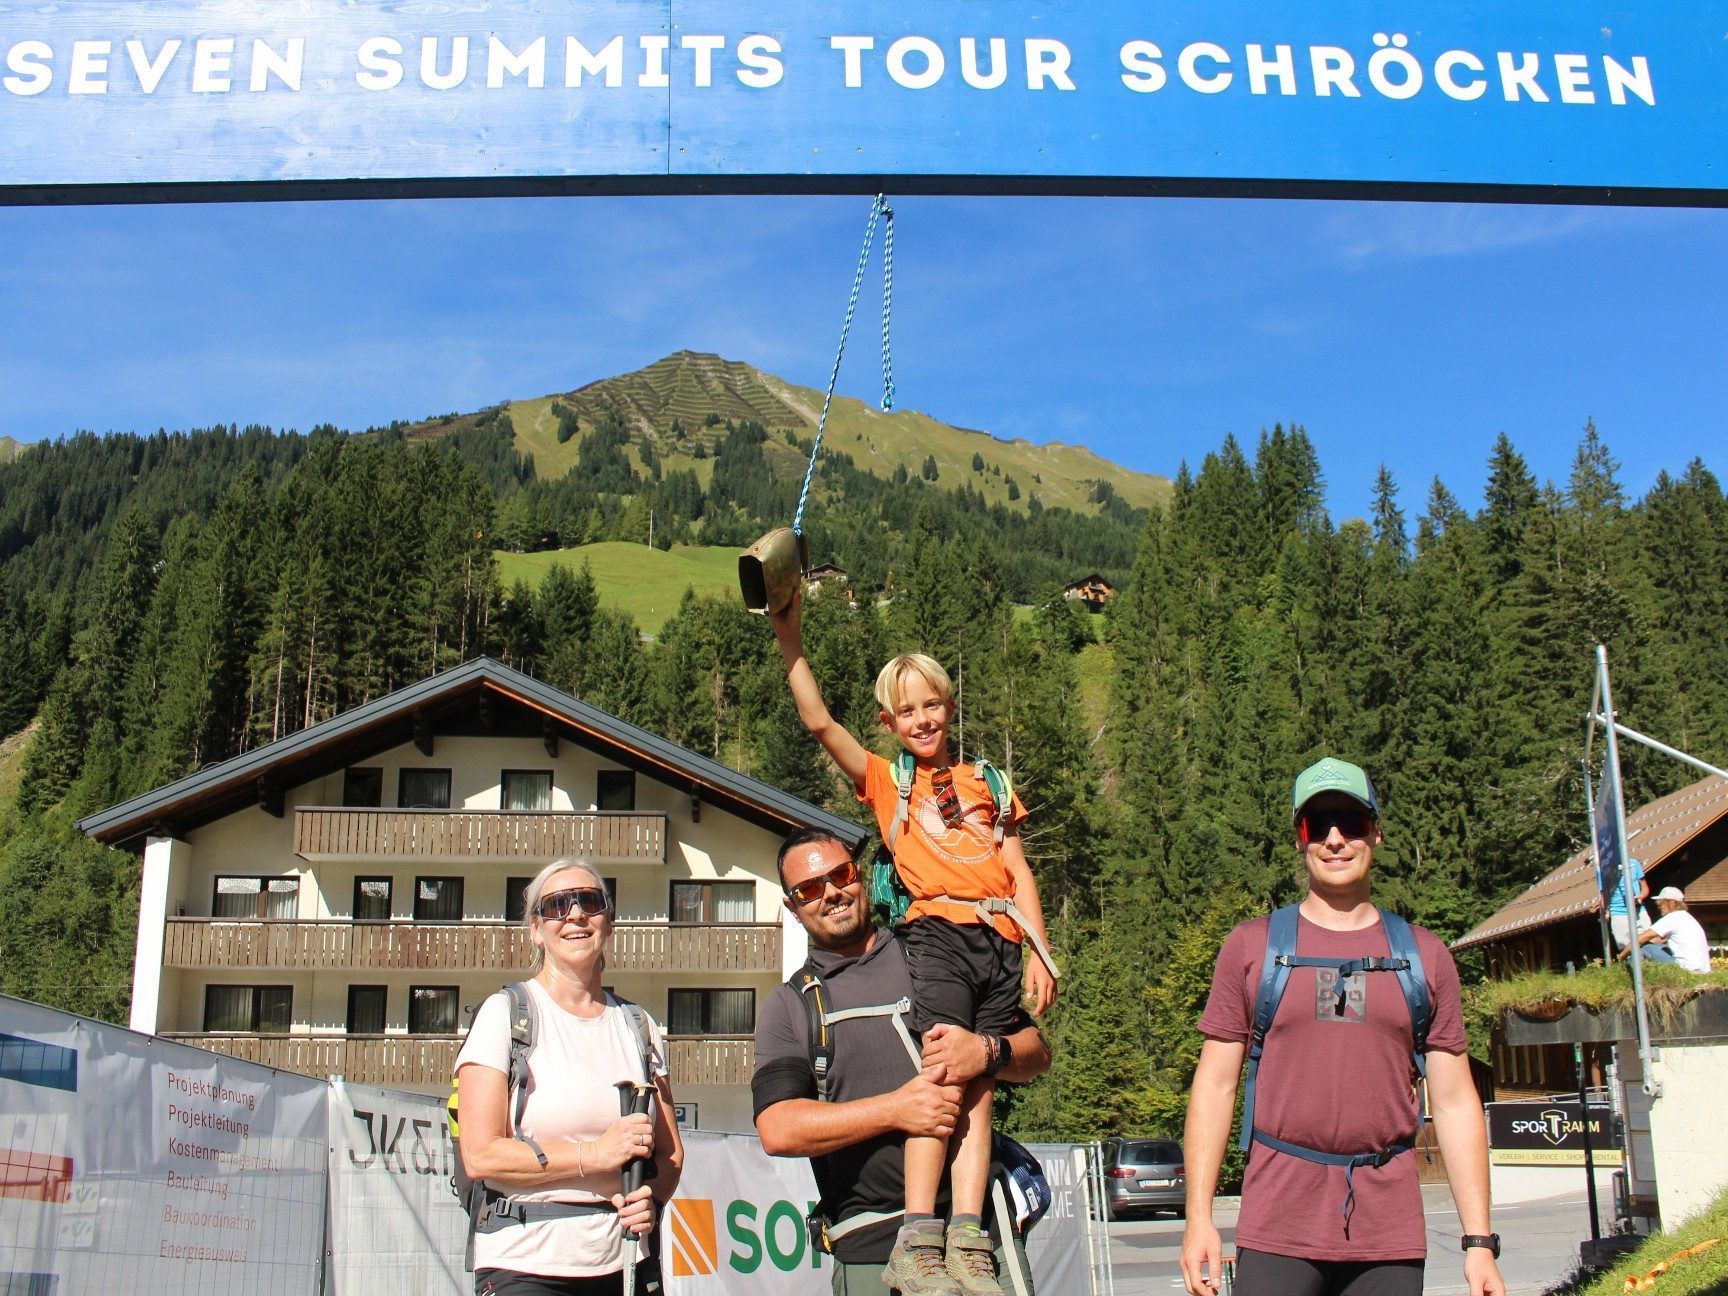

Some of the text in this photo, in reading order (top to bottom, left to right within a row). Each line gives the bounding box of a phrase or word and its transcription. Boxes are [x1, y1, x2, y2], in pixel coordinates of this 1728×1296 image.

[3, 32, 1656, 106] SEVEN SUMMITS TOUR SCHRÖCKEN
[168, 1072, 256, 1111] Projektplanung
[169, 1104, 250, 1140] Projektleitung
[169, 1137, 279, 1172] Kostenmanagement
[167, 1170, 229, 1200] Bauleitung
[164, 1204, 257, 1231] Baukoordination
[159, 1239, 248, 1263] Energieausweis
